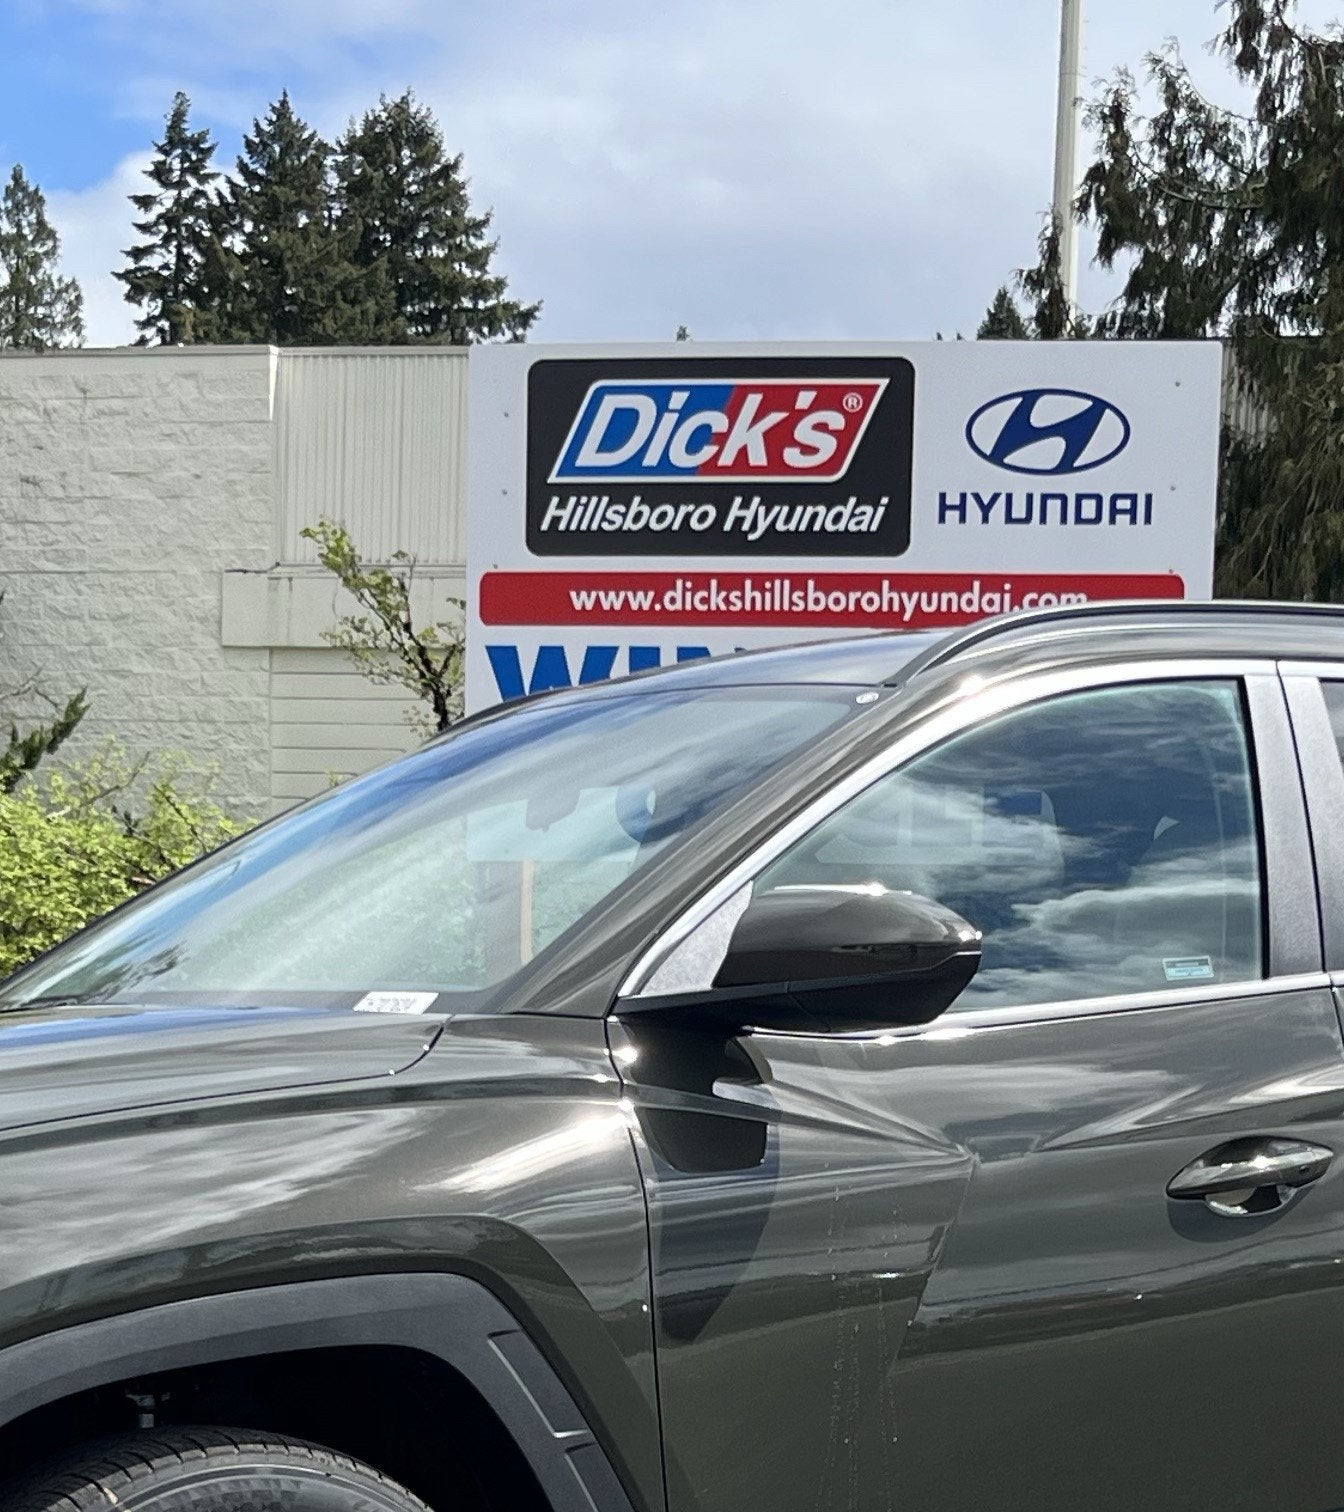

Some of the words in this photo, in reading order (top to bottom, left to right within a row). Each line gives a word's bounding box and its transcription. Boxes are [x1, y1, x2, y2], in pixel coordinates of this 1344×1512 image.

[574, 388, 849, 468] Dick's
[539, 495, 717, 533] Hillsboro
[722, 494, 891, 541] Hyundai
[937, 490, 1153, 527] HYUNDAI
[569, 578, 1088, 621] www.dickshillsborohyundai.com
